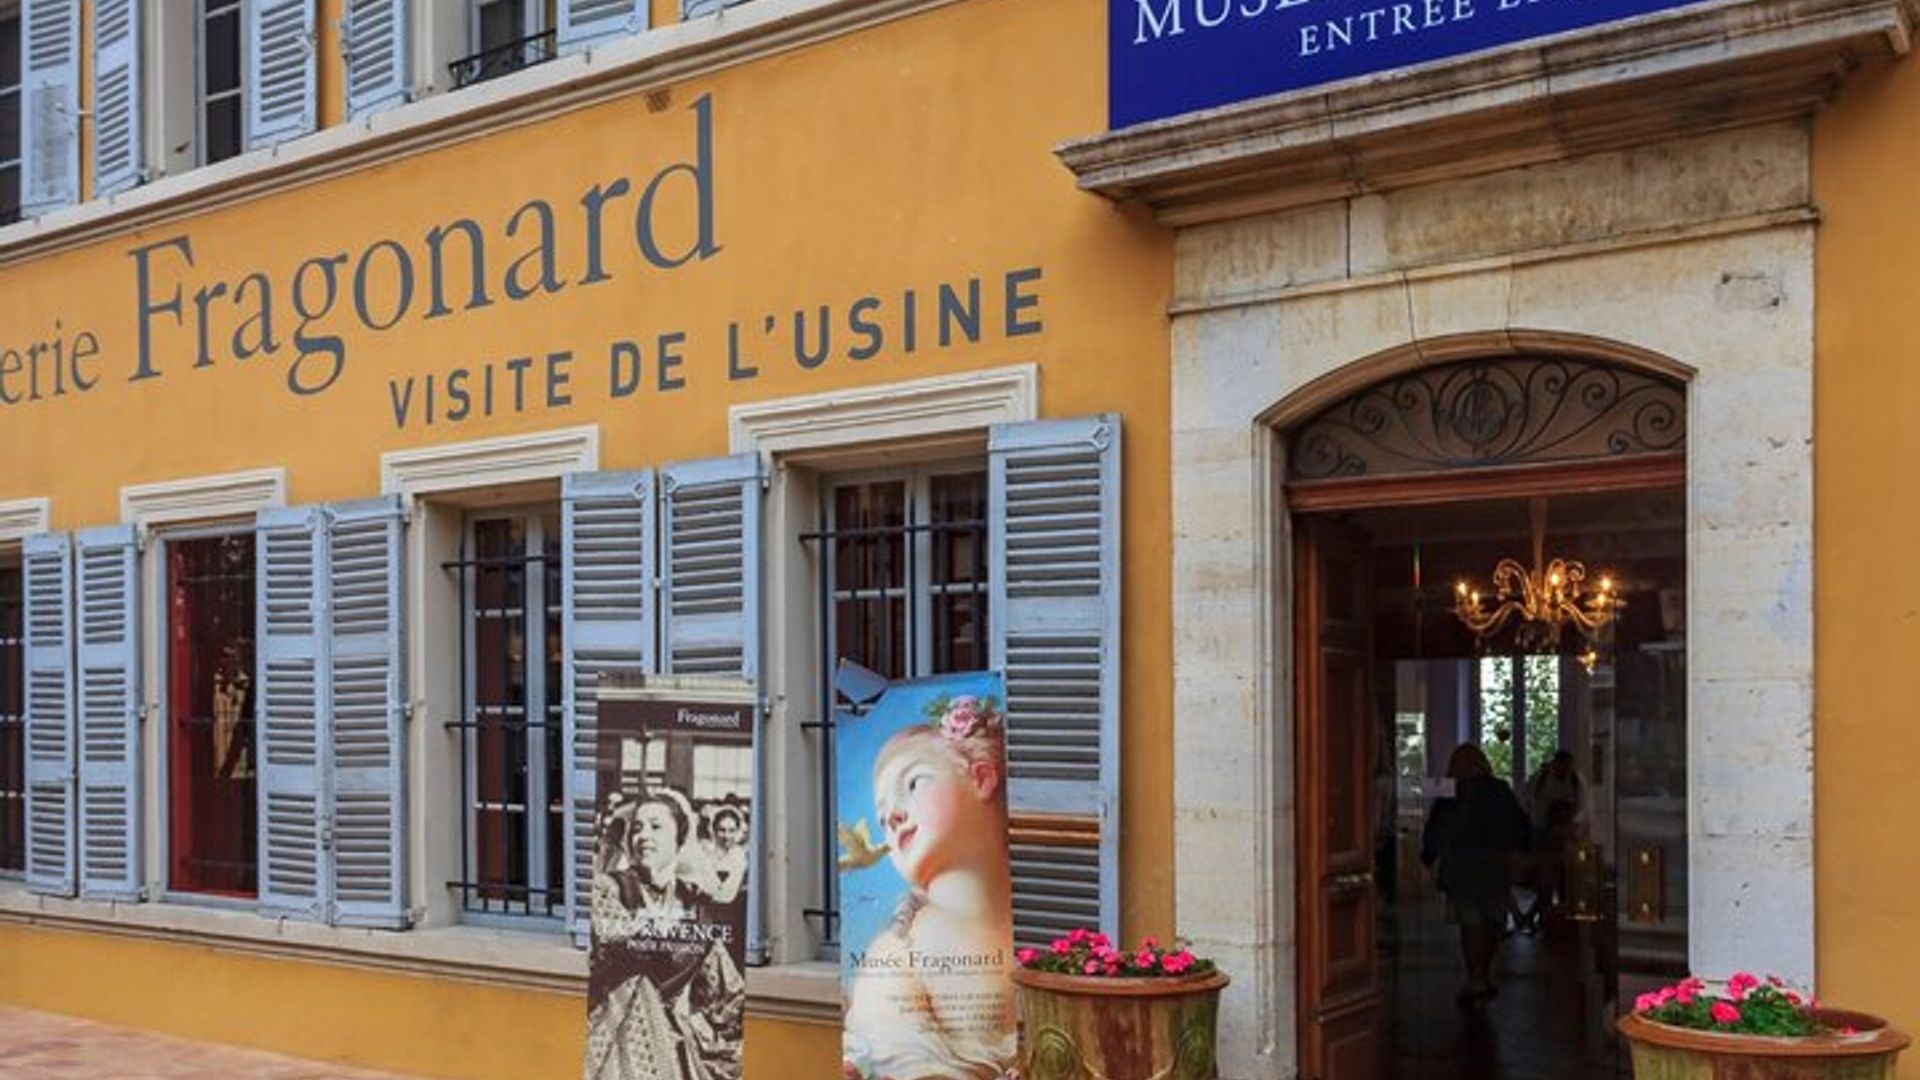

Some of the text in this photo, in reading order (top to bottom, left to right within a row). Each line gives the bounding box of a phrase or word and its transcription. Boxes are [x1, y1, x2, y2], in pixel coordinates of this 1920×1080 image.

[1133, 0, 1310, 45] MU
[0, 93, 722, 405] erie Fragonard
[388, 266, 1044, 428] VISITE DE L'USINE
[850, 948, 1004, 975] Musée Fragonard
